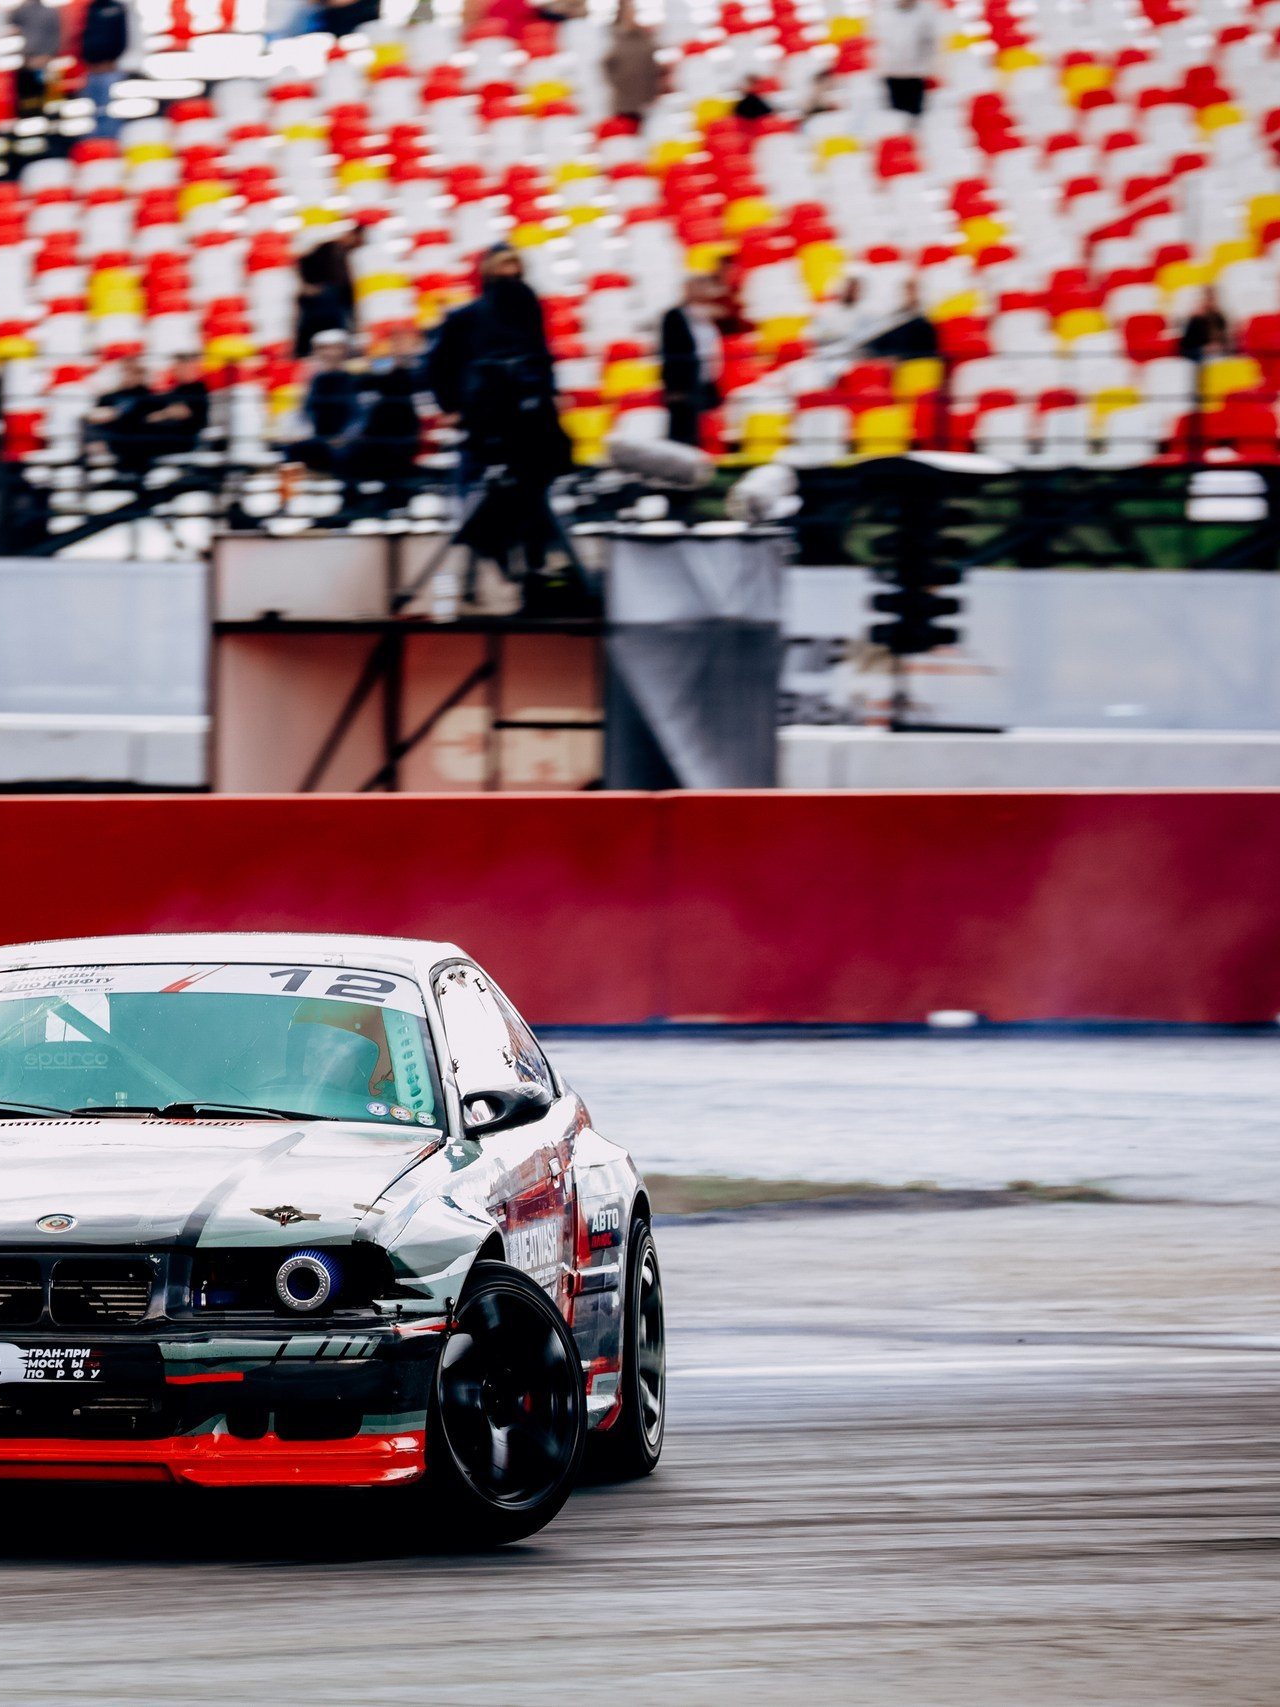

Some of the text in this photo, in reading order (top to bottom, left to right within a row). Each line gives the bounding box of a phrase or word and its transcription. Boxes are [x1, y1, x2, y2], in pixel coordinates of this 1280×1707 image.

[43, 976, 115, 989] ДРИФТУ
[269, 968, 397, 1003] 12
[24, 1052, 109, 1070] sparco
[591, 1208, 619, 1233] АВТО
[28, 1348, 91, 1358] ГРАН-ПРИ
[26, 1369, 45, 1379] ПО
